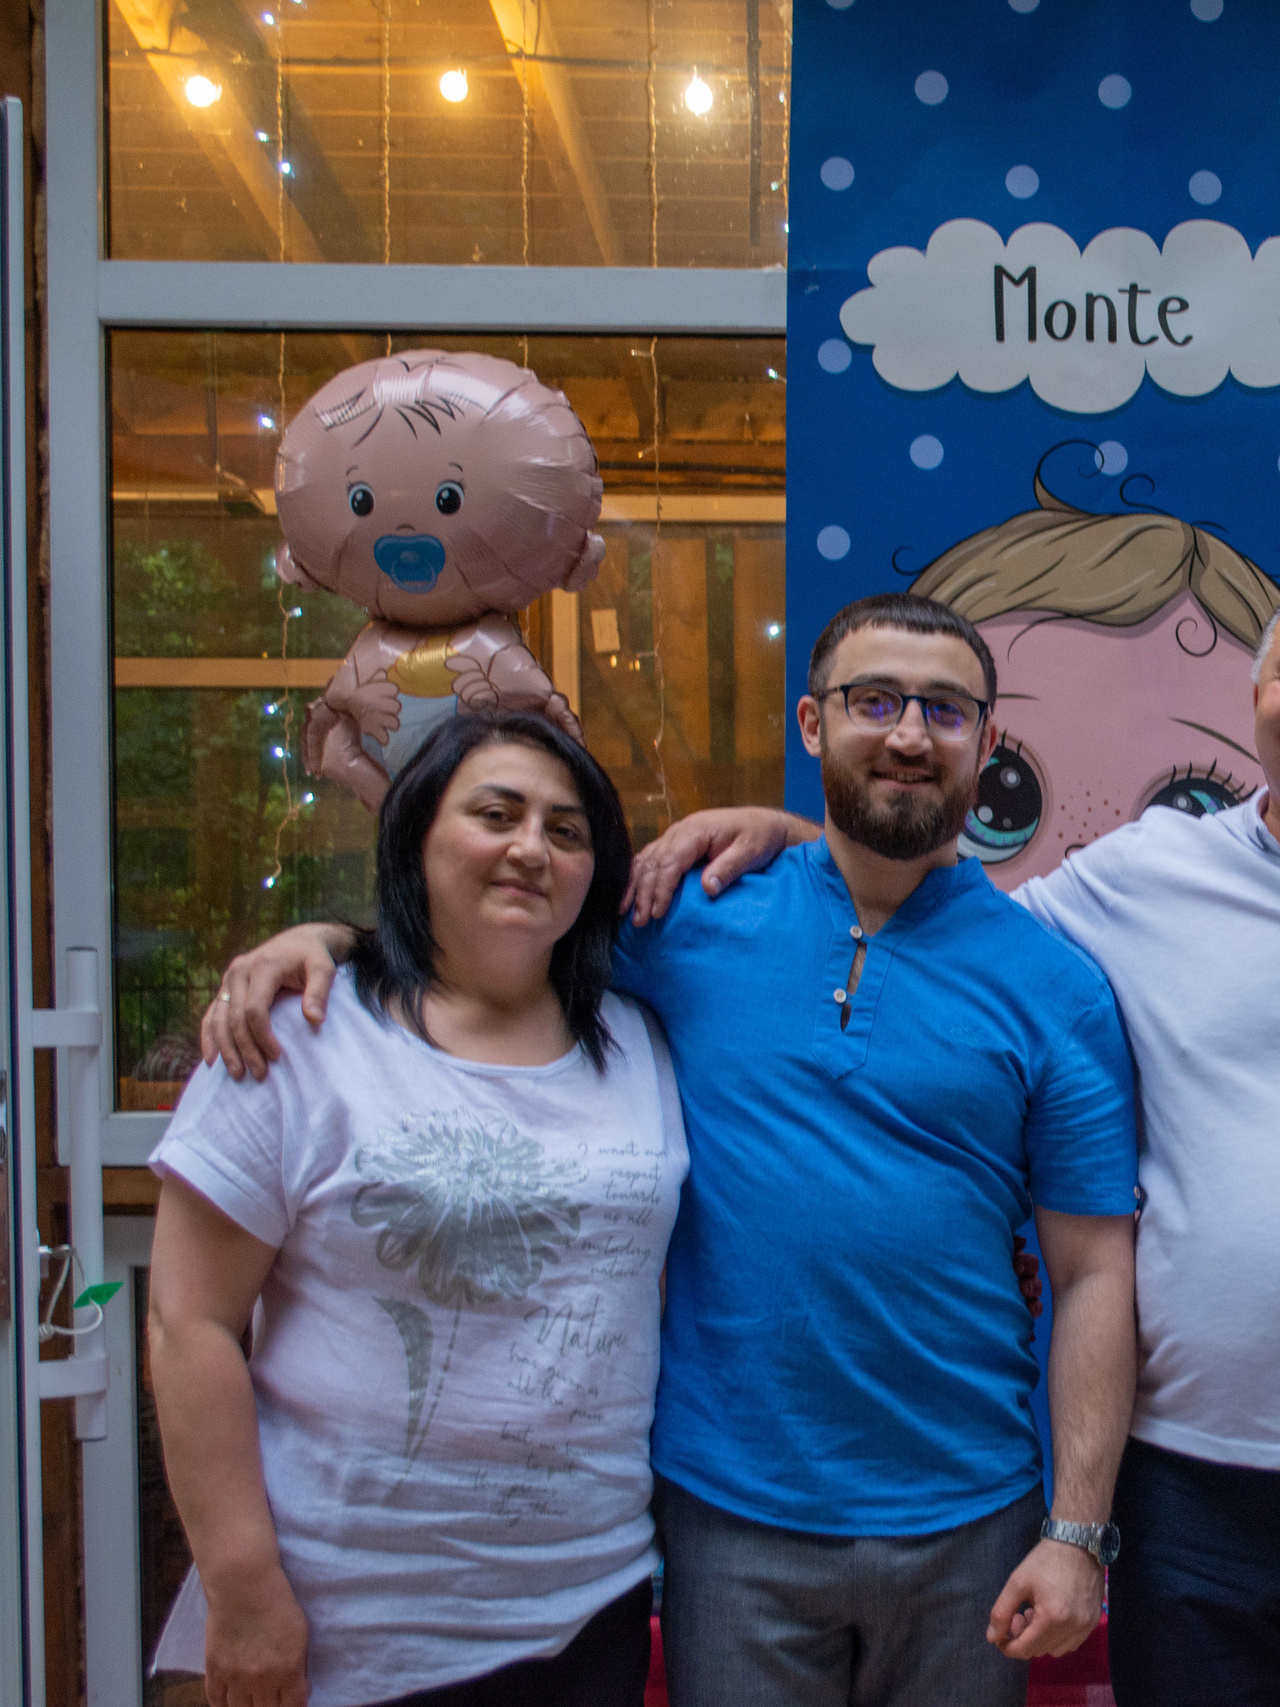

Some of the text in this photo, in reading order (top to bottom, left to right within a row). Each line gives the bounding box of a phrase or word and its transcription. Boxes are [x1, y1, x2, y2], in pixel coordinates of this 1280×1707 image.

[993, 264, 1193, 347] Monte
[610, 1163, 662, 1189] respect
[523, 1294, 627, 1358] Nature
